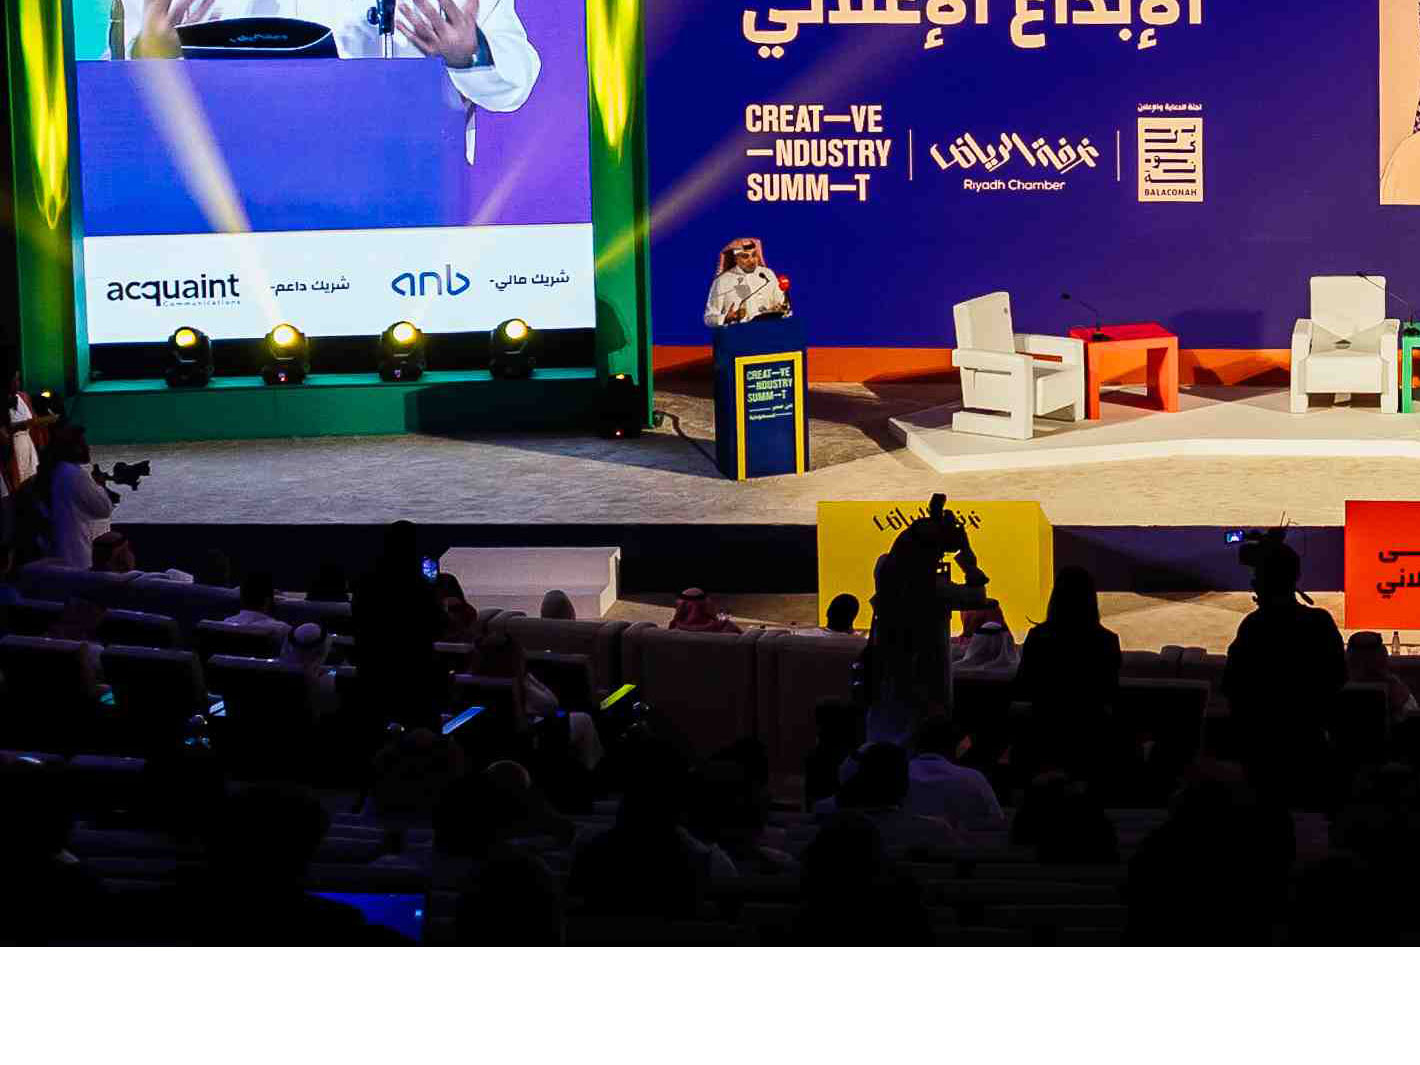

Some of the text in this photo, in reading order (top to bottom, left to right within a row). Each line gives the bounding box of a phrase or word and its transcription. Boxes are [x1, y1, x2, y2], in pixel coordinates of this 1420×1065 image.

[963, 178, 1066, 193] Riyadh Chamber
[311, 275, 350, 294] شريك
[391, 263, 471, 297] anb
[531, 269, 571, 288] شريك
[106, 273, 240, 307] acquaint
